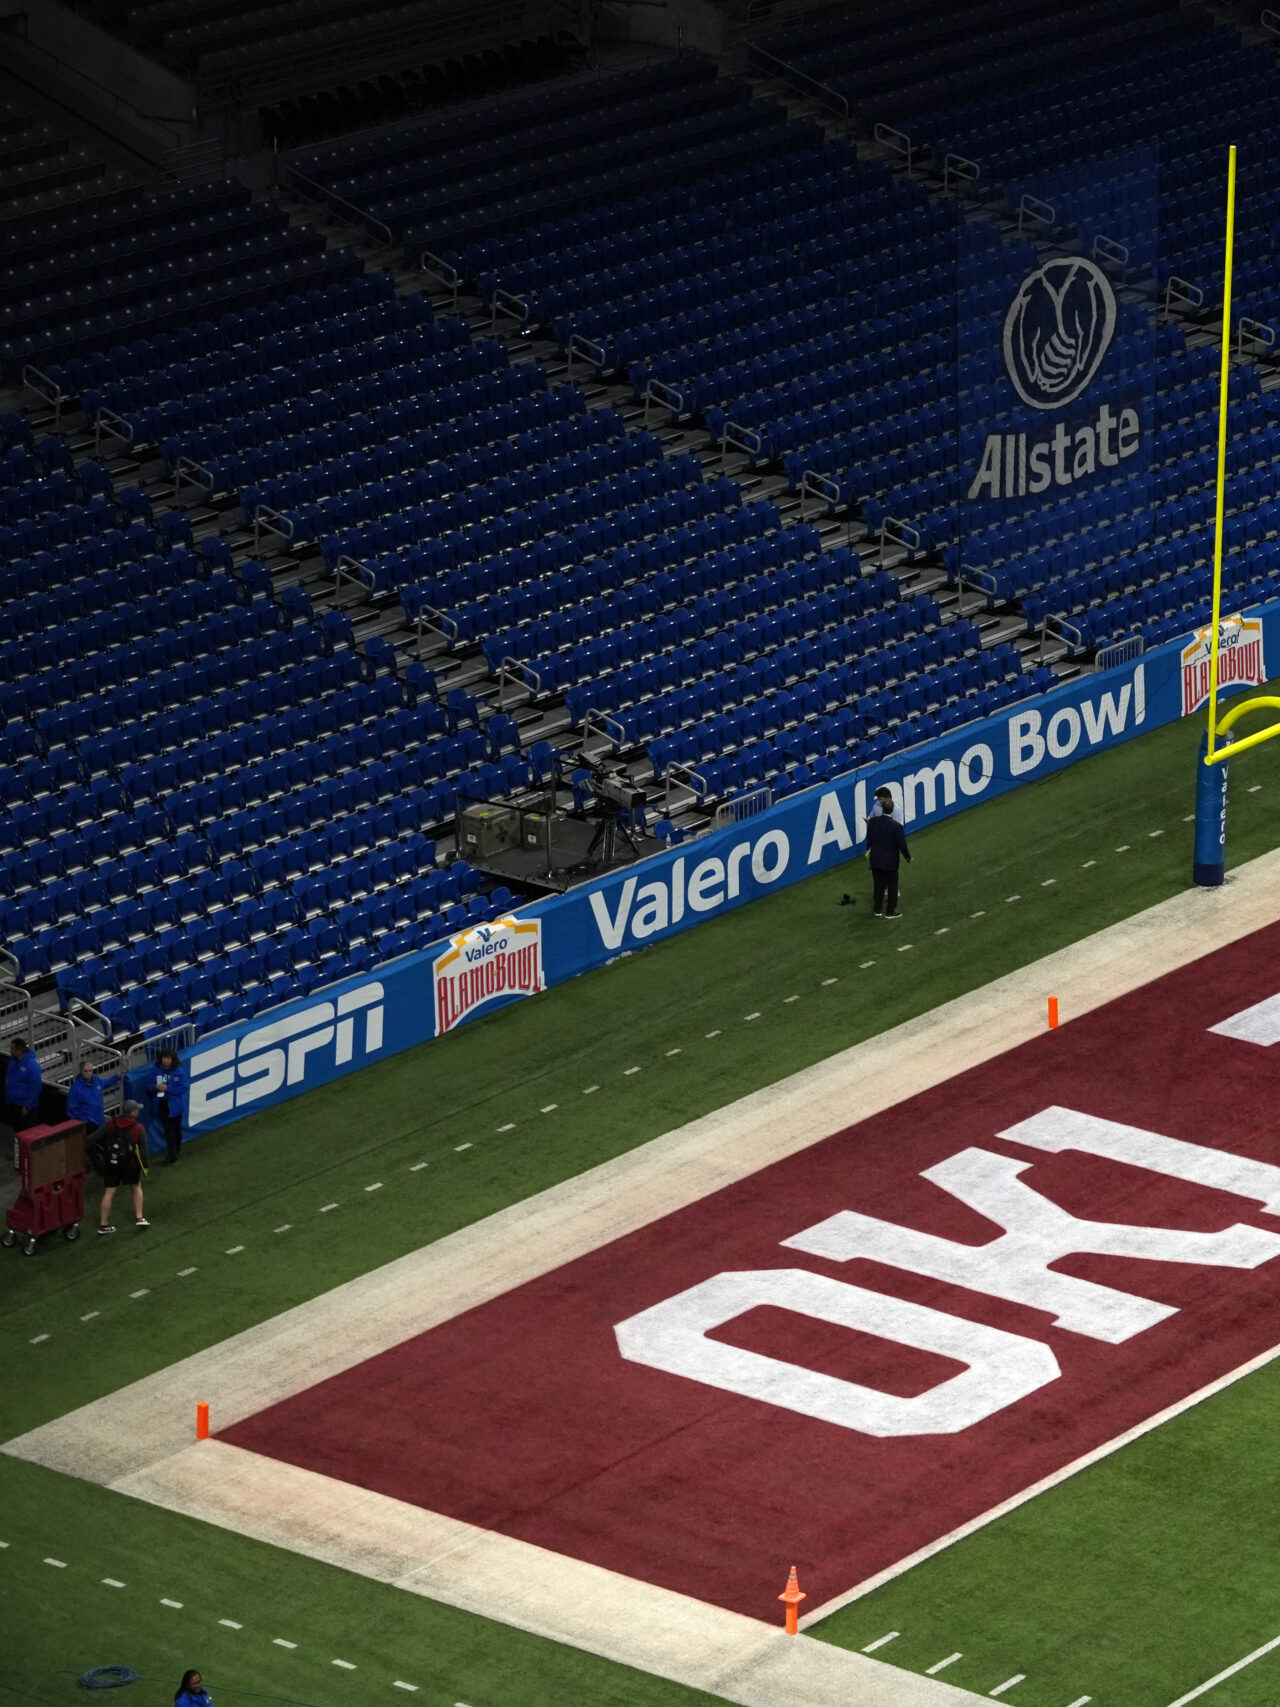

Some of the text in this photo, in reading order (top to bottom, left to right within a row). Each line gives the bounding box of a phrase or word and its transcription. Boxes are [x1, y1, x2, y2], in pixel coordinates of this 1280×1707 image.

[967, 404, 1139, 499] Allstate
[1205, 634, 1238, 654] Vlero
[589, 829, 790, 950] Valero
[1008, 663, 1146, 776] Bowl
[465, 938, 508, 962] Valero
[188, 981, 385, 1127] ESPN
